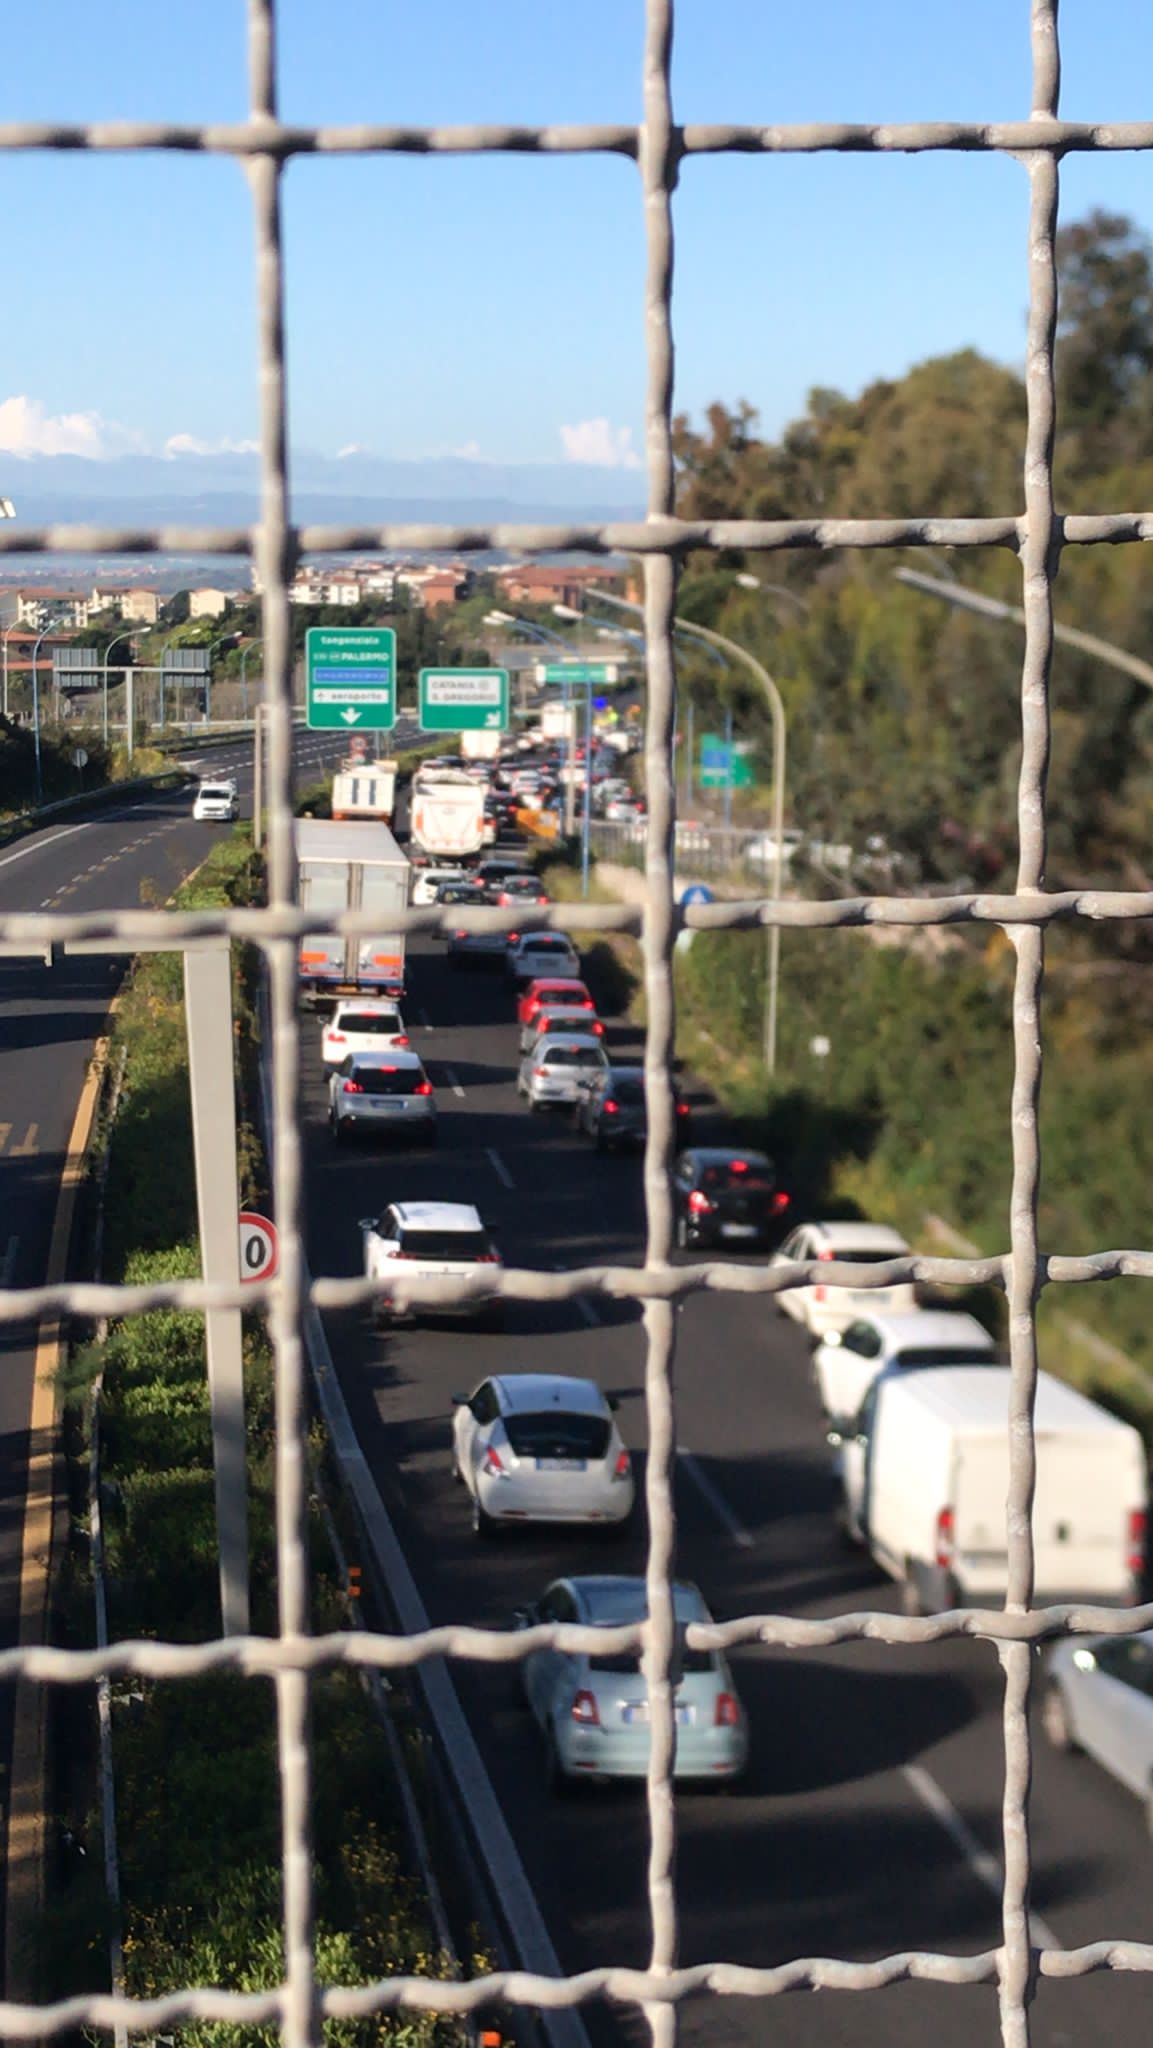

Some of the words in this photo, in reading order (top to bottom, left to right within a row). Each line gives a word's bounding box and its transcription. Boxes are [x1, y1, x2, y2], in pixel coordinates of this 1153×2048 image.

[341, 651, 390, 661] PALERMO
[431, 680, 476, 689] CATANIA
[331, 692, 383, 702] aeroporto
